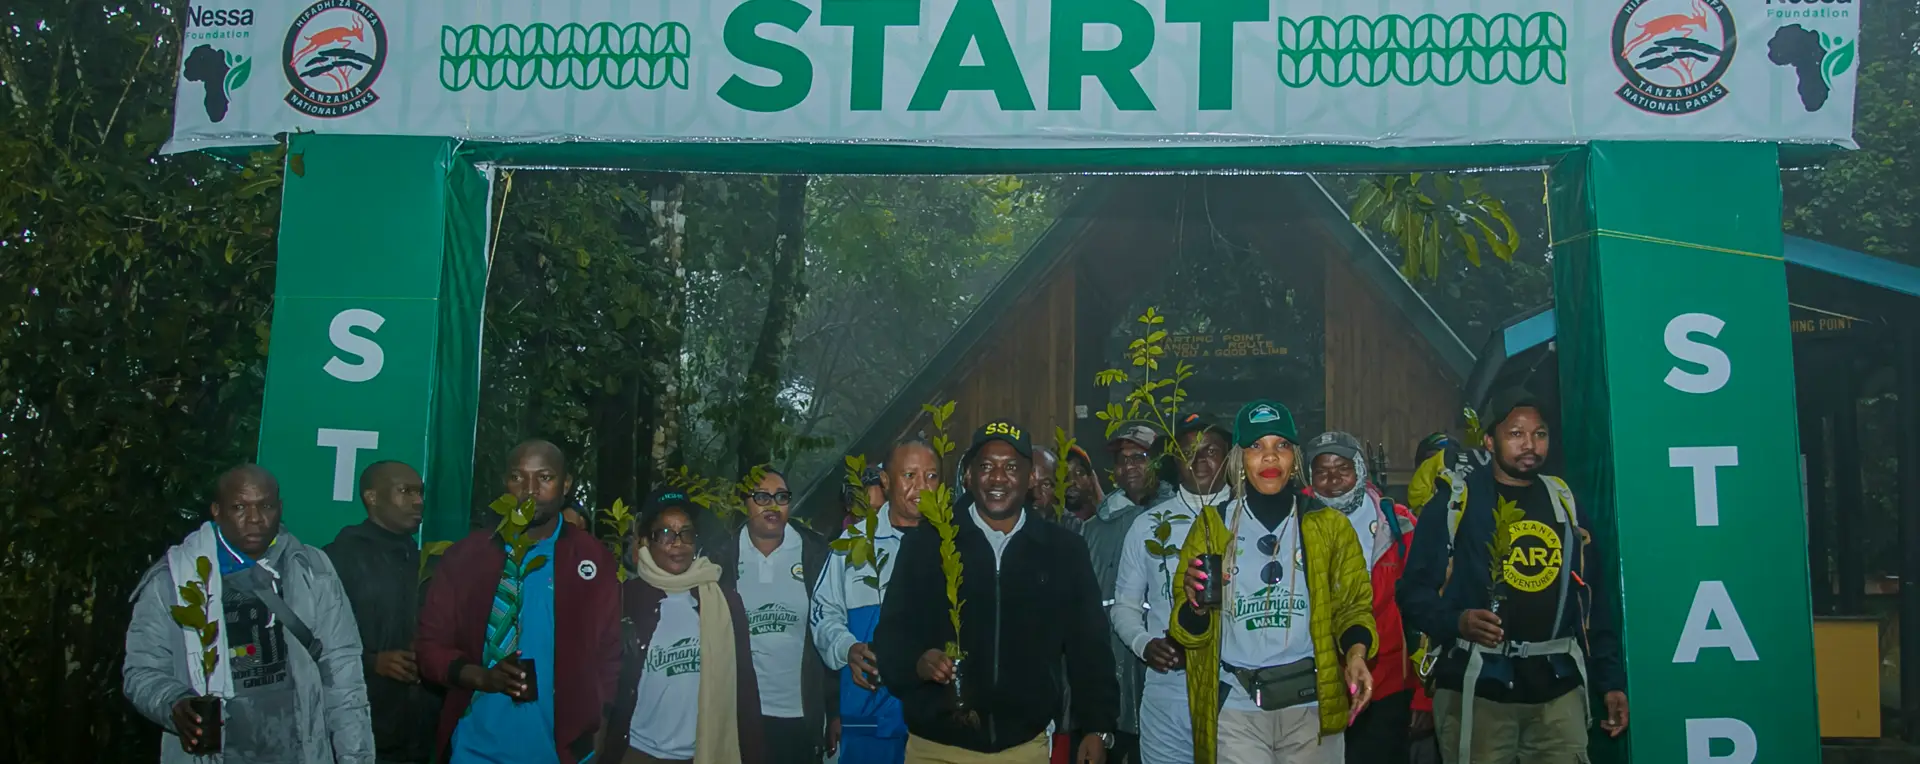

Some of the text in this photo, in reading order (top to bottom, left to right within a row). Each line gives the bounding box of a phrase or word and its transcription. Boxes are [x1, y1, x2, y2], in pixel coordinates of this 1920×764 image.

[187, 5, 254, 27] Nessa
[296, 0, 335, 28] HIFADHI
[355, 3, 378, 26] TAIFA
[1767, 8, 1849, 18] Foundation
[186, 31, 249, 39] Foundation
[717, 0, 1269, 112] START
[303, 87, 362, 103] TANZANIA
[1638, 80, 1708, 97] TANZANIA
[291, 93, 373, 115] NATIONAL PARKS
[1623, 86, 1722, 111] NATIONAL PARKS
[1819, 318, 1852, 331] POINT
[1222, 334, 1265, 343] POINT
[1503, 547, 1562, 567] ARA
[1504, 569, 1553, 588] ADVENTURES
[756, 624, 783, 633] WALK
[1252, 617, 1288, 628] WALK
